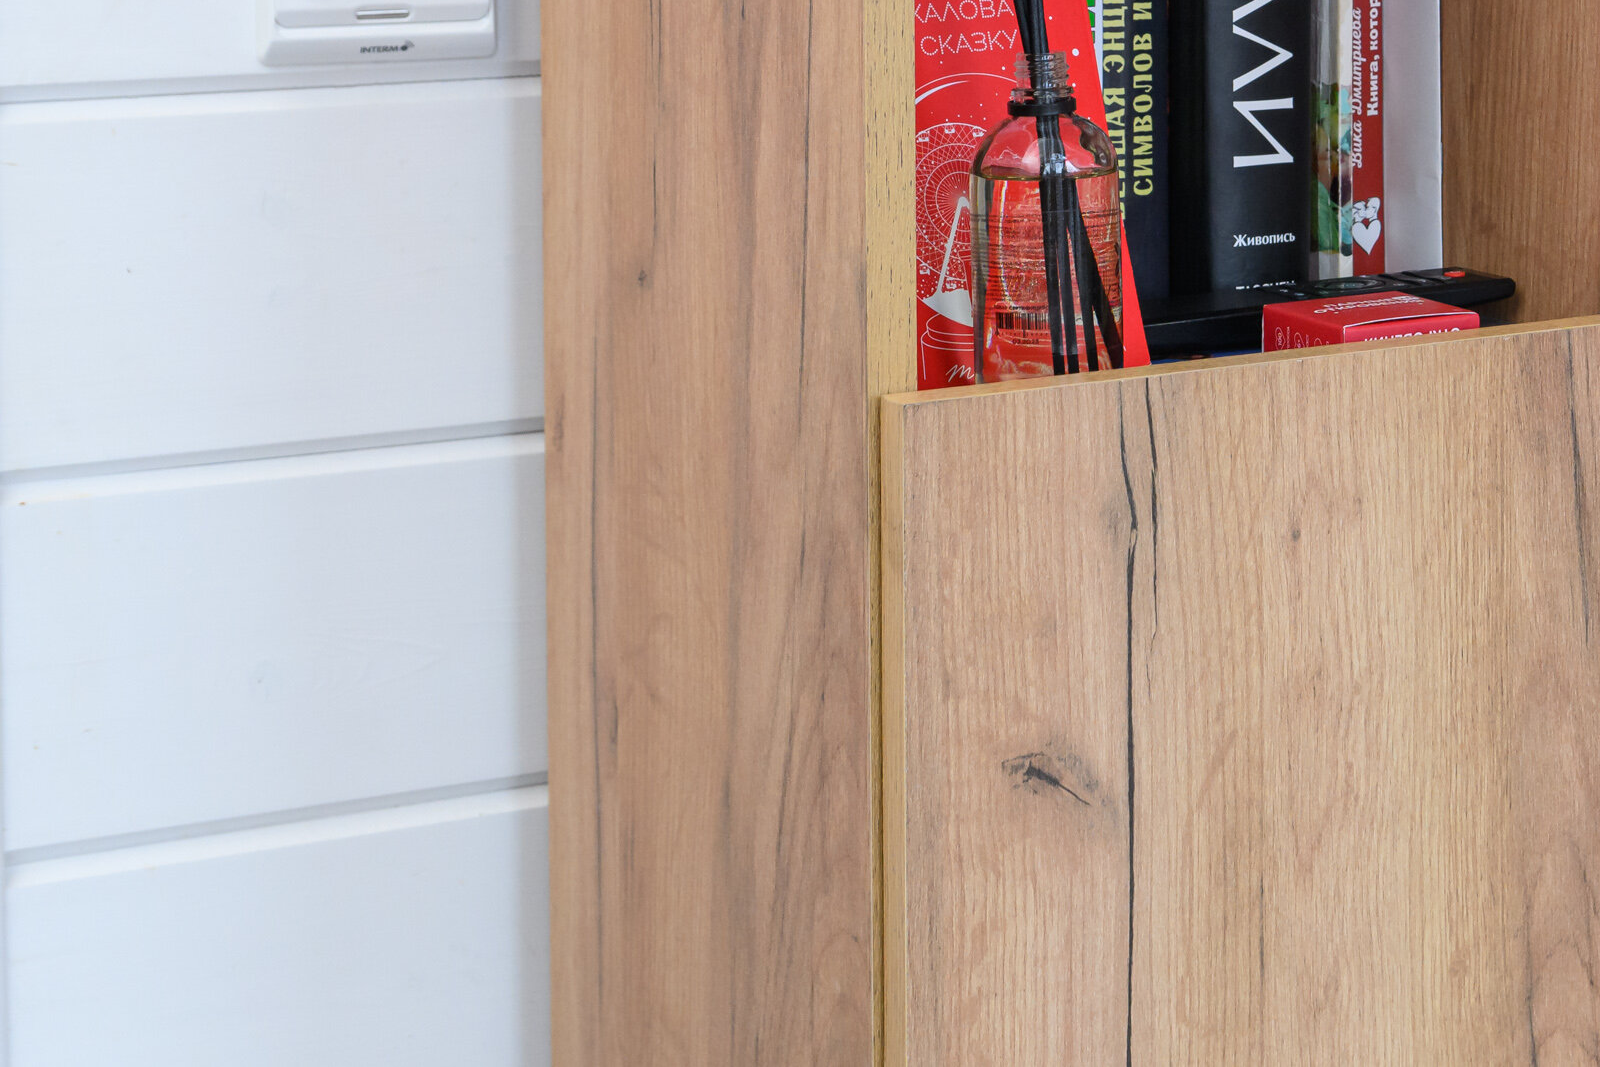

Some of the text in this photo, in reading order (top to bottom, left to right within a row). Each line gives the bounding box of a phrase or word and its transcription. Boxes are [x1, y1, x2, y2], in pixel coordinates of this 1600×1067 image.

[1133, 1, 1153, 21] И
[920, 29, 1018, 56] СКАЗКУ
[1133, 32, 1153, 197] СИМВОЛОВ
[1352, 7, 1366, 169] Вика Дмитриева
[1367, 55, 1380, 117] Книга,
